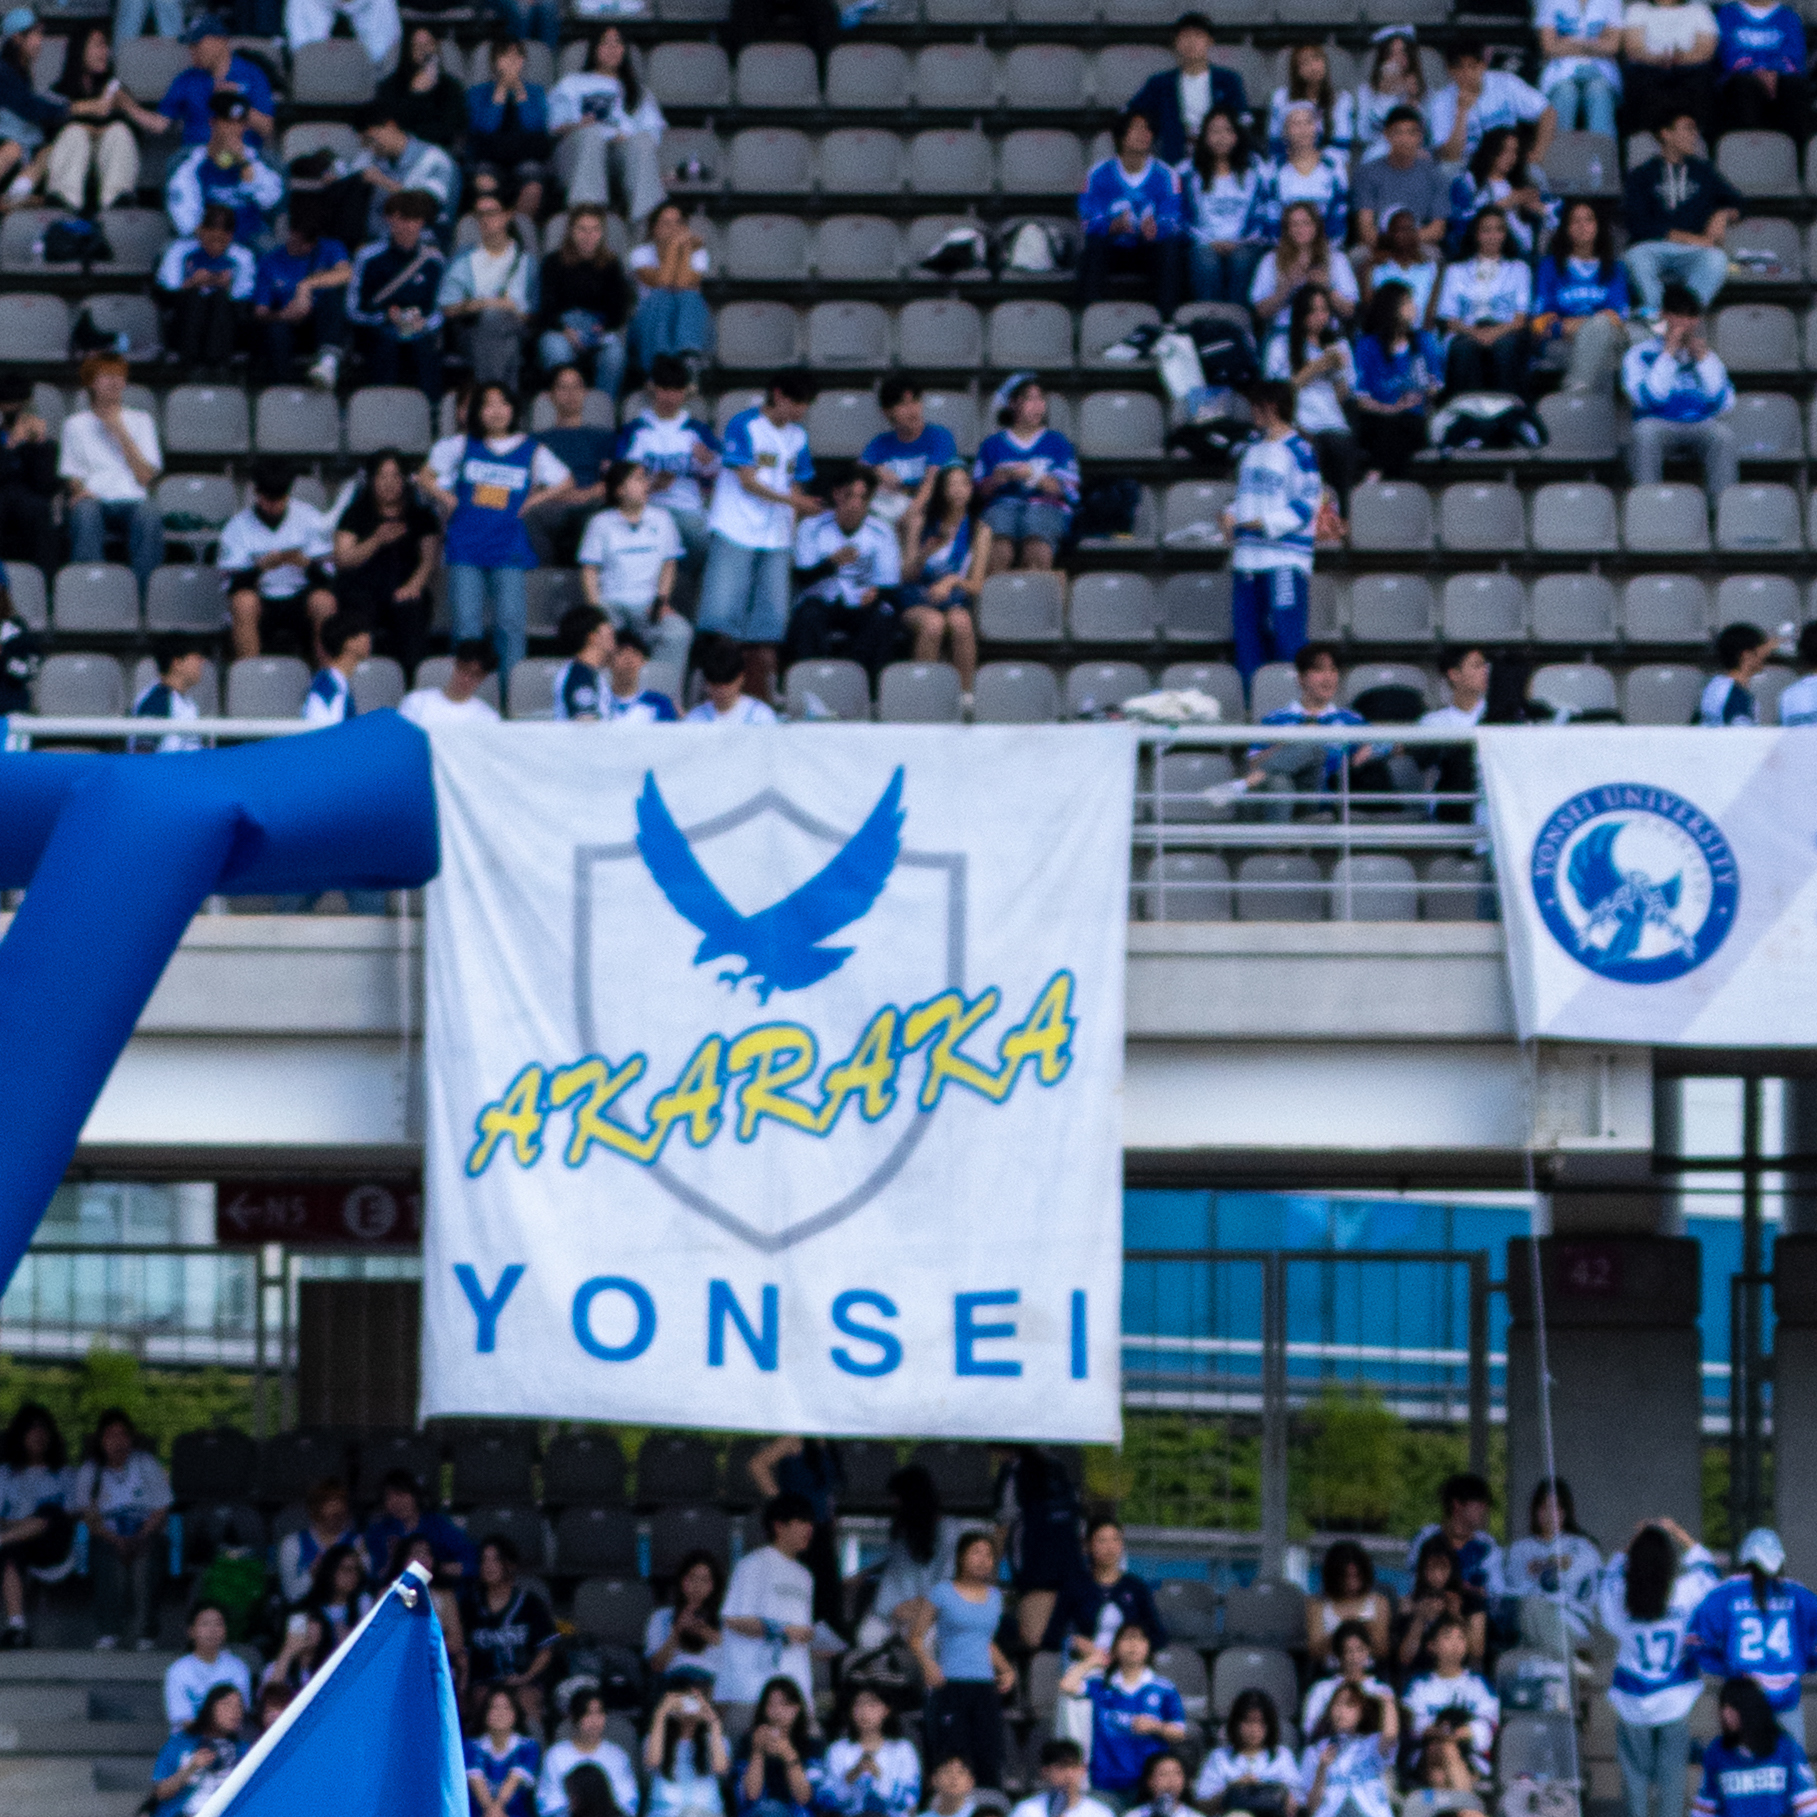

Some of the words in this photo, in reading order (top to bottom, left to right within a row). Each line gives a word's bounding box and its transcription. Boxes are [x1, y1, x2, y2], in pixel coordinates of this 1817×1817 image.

[1536, 786, 1598, 877] YONSEI
[1604, 783, 1738, 885] UNIVERSITY
[466, 969, 1076, 1178] AKARAKA
[453, 1264, 1089, 1379] YONSEI
[1635, 1631, 1678, 1673] 17
[1738, 1617, 1792, 1661] 24
